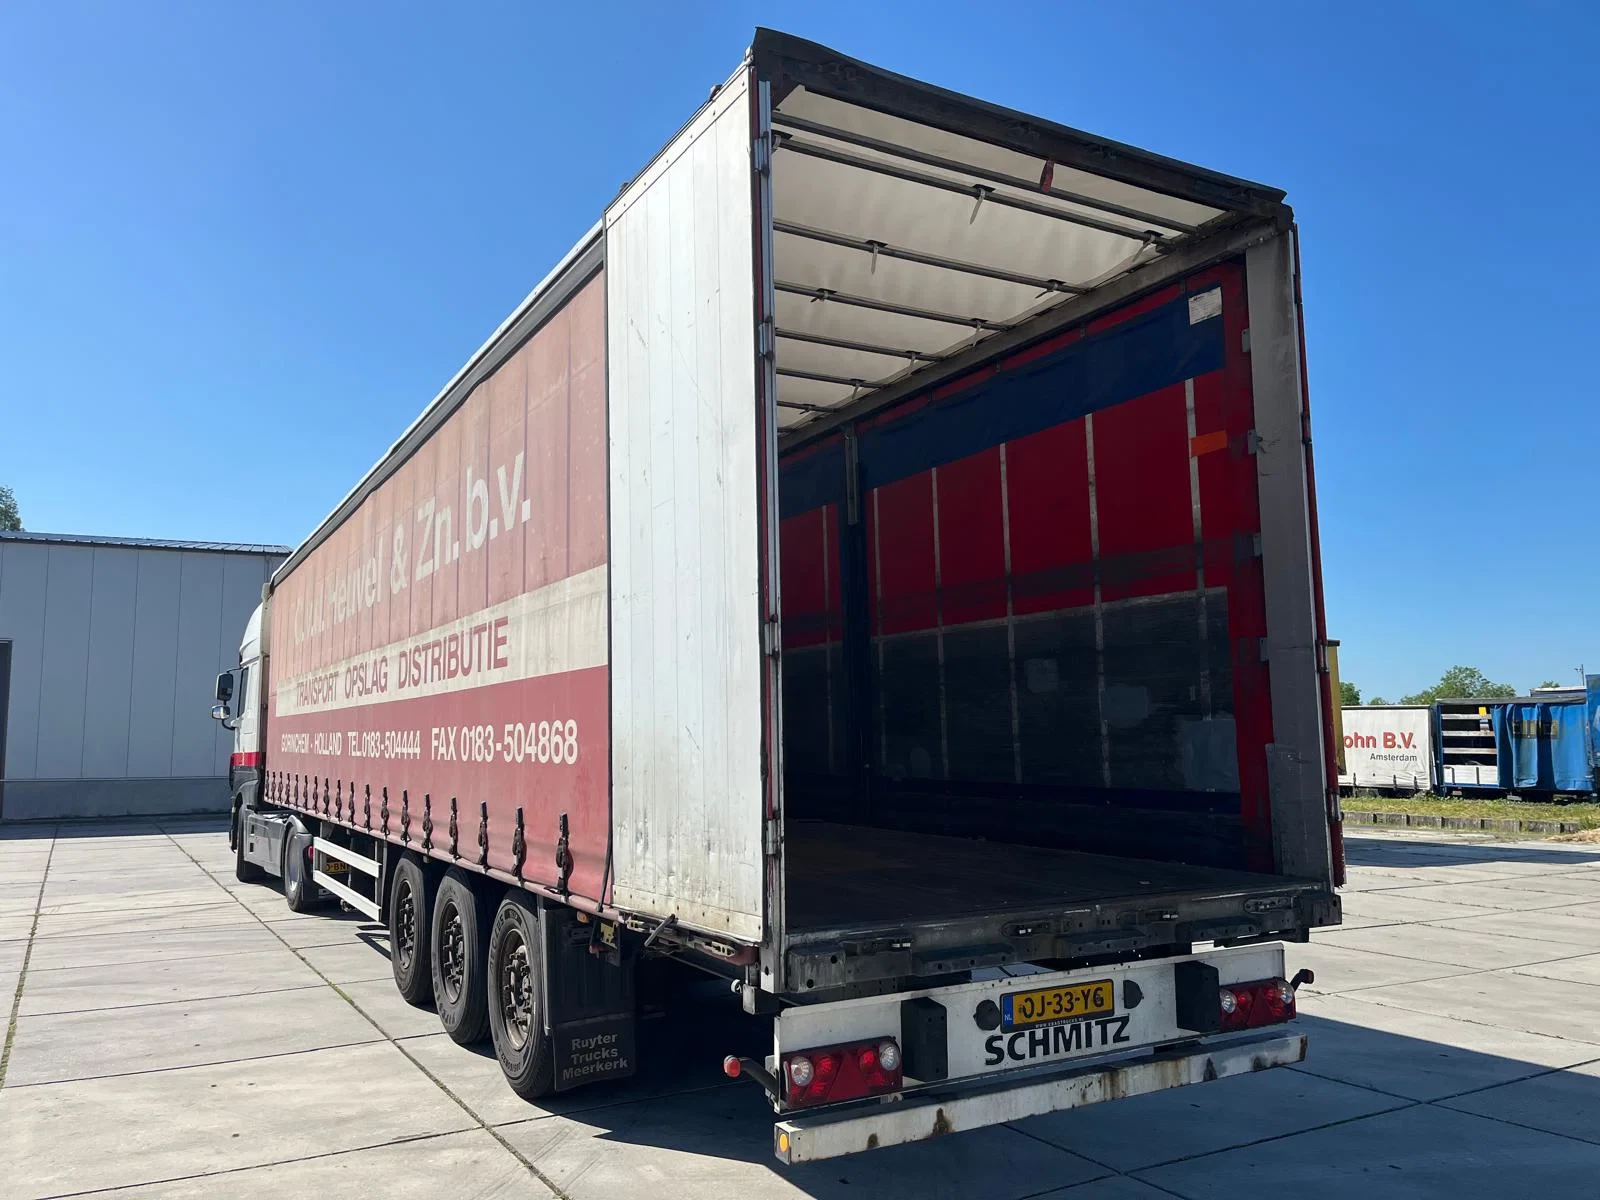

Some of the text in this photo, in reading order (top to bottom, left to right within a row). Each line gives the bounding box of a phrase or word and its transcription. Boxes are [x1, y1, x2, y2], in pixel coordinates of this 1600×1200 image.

[390, 523, 407, 594] &
[296, 617, 508, 707] TRANSPORT OPSLAG DISTRIBUTIE
[314, 732, 342, 756] HOLLAND
[431, 727, 457, 761] FAX
[461, 719, 578, 765] 0183-504868
[1383, 731, 1417, 749] B.V.
[1370, 752, 1418, 762] Amsterdam
[1022, 987, 1104, 1019] OJ-33-YG
[571, 1033, 618, 1051] Ruyter
[985, 1013, 1131, 1066] SCHMITZ
[562, 1058, 628, 1081] Meerkerk
[571, 1047, 618, 1065] Trucks
